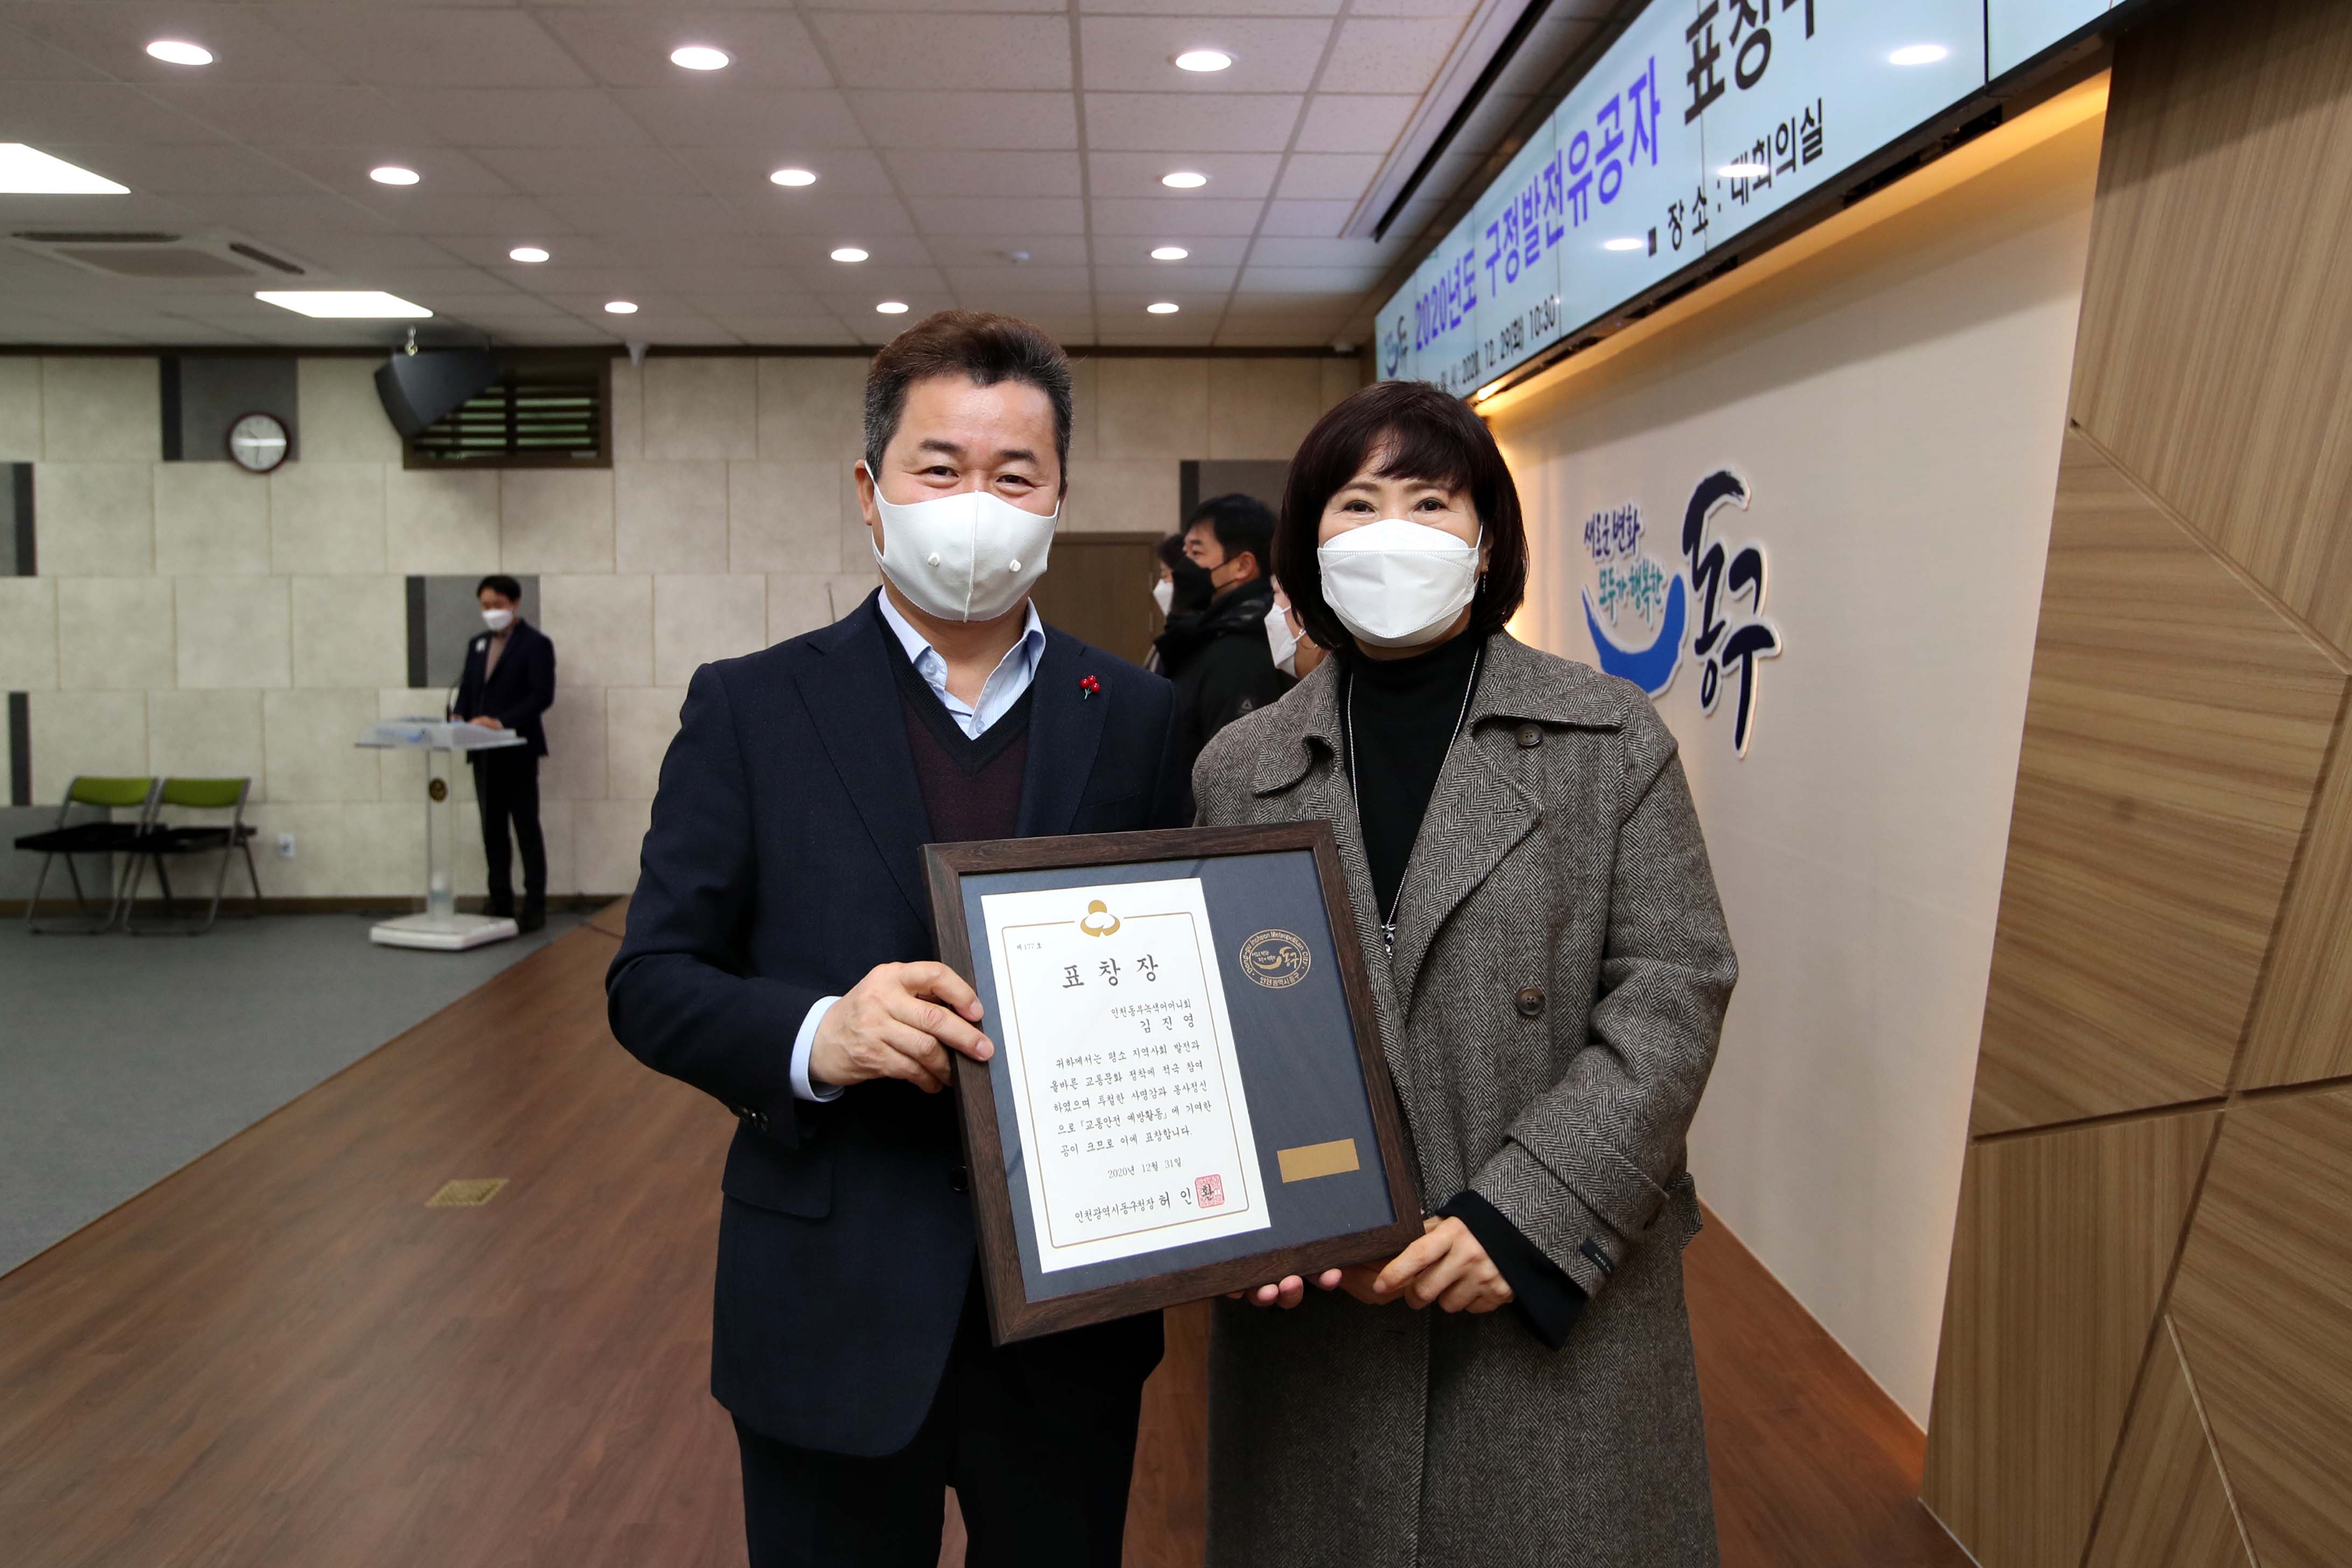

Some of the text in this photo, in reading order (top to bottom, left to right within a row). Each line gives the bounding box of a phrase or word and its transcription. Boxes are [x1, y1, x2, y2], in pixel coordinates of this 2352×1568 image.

[1416, 248, 1477, 351] 2020년도
[1485, 55, 1661, 297] 구정발전유공자
[1250, 933, 1271, 946] Incheon
[1056, 1040, 1200, 1069] 귀하께서는 평소 지역사회 발전과
[1050, 1060, 1203, 1093] 올바른 교통문화 정착에 적극 참여
[1054, 1098, 1090, 1113] 하였으며
[1131, 1087, 1167, 1101] 사명감과
[1174, 1080, 1207, 1095] 봉사정신
[1058, 1123, 1075, 1135] 으로
[1186, 1100, 1212, 1114] 기여한
[1061, 1125, 1192, 1157] 공이 크므로 이에 표창합니다.
[1108, 1157, 1181, 1178] 2020년 12월 31일
[1075, 1197, 1154, 1223] 인천광역시동구청장
